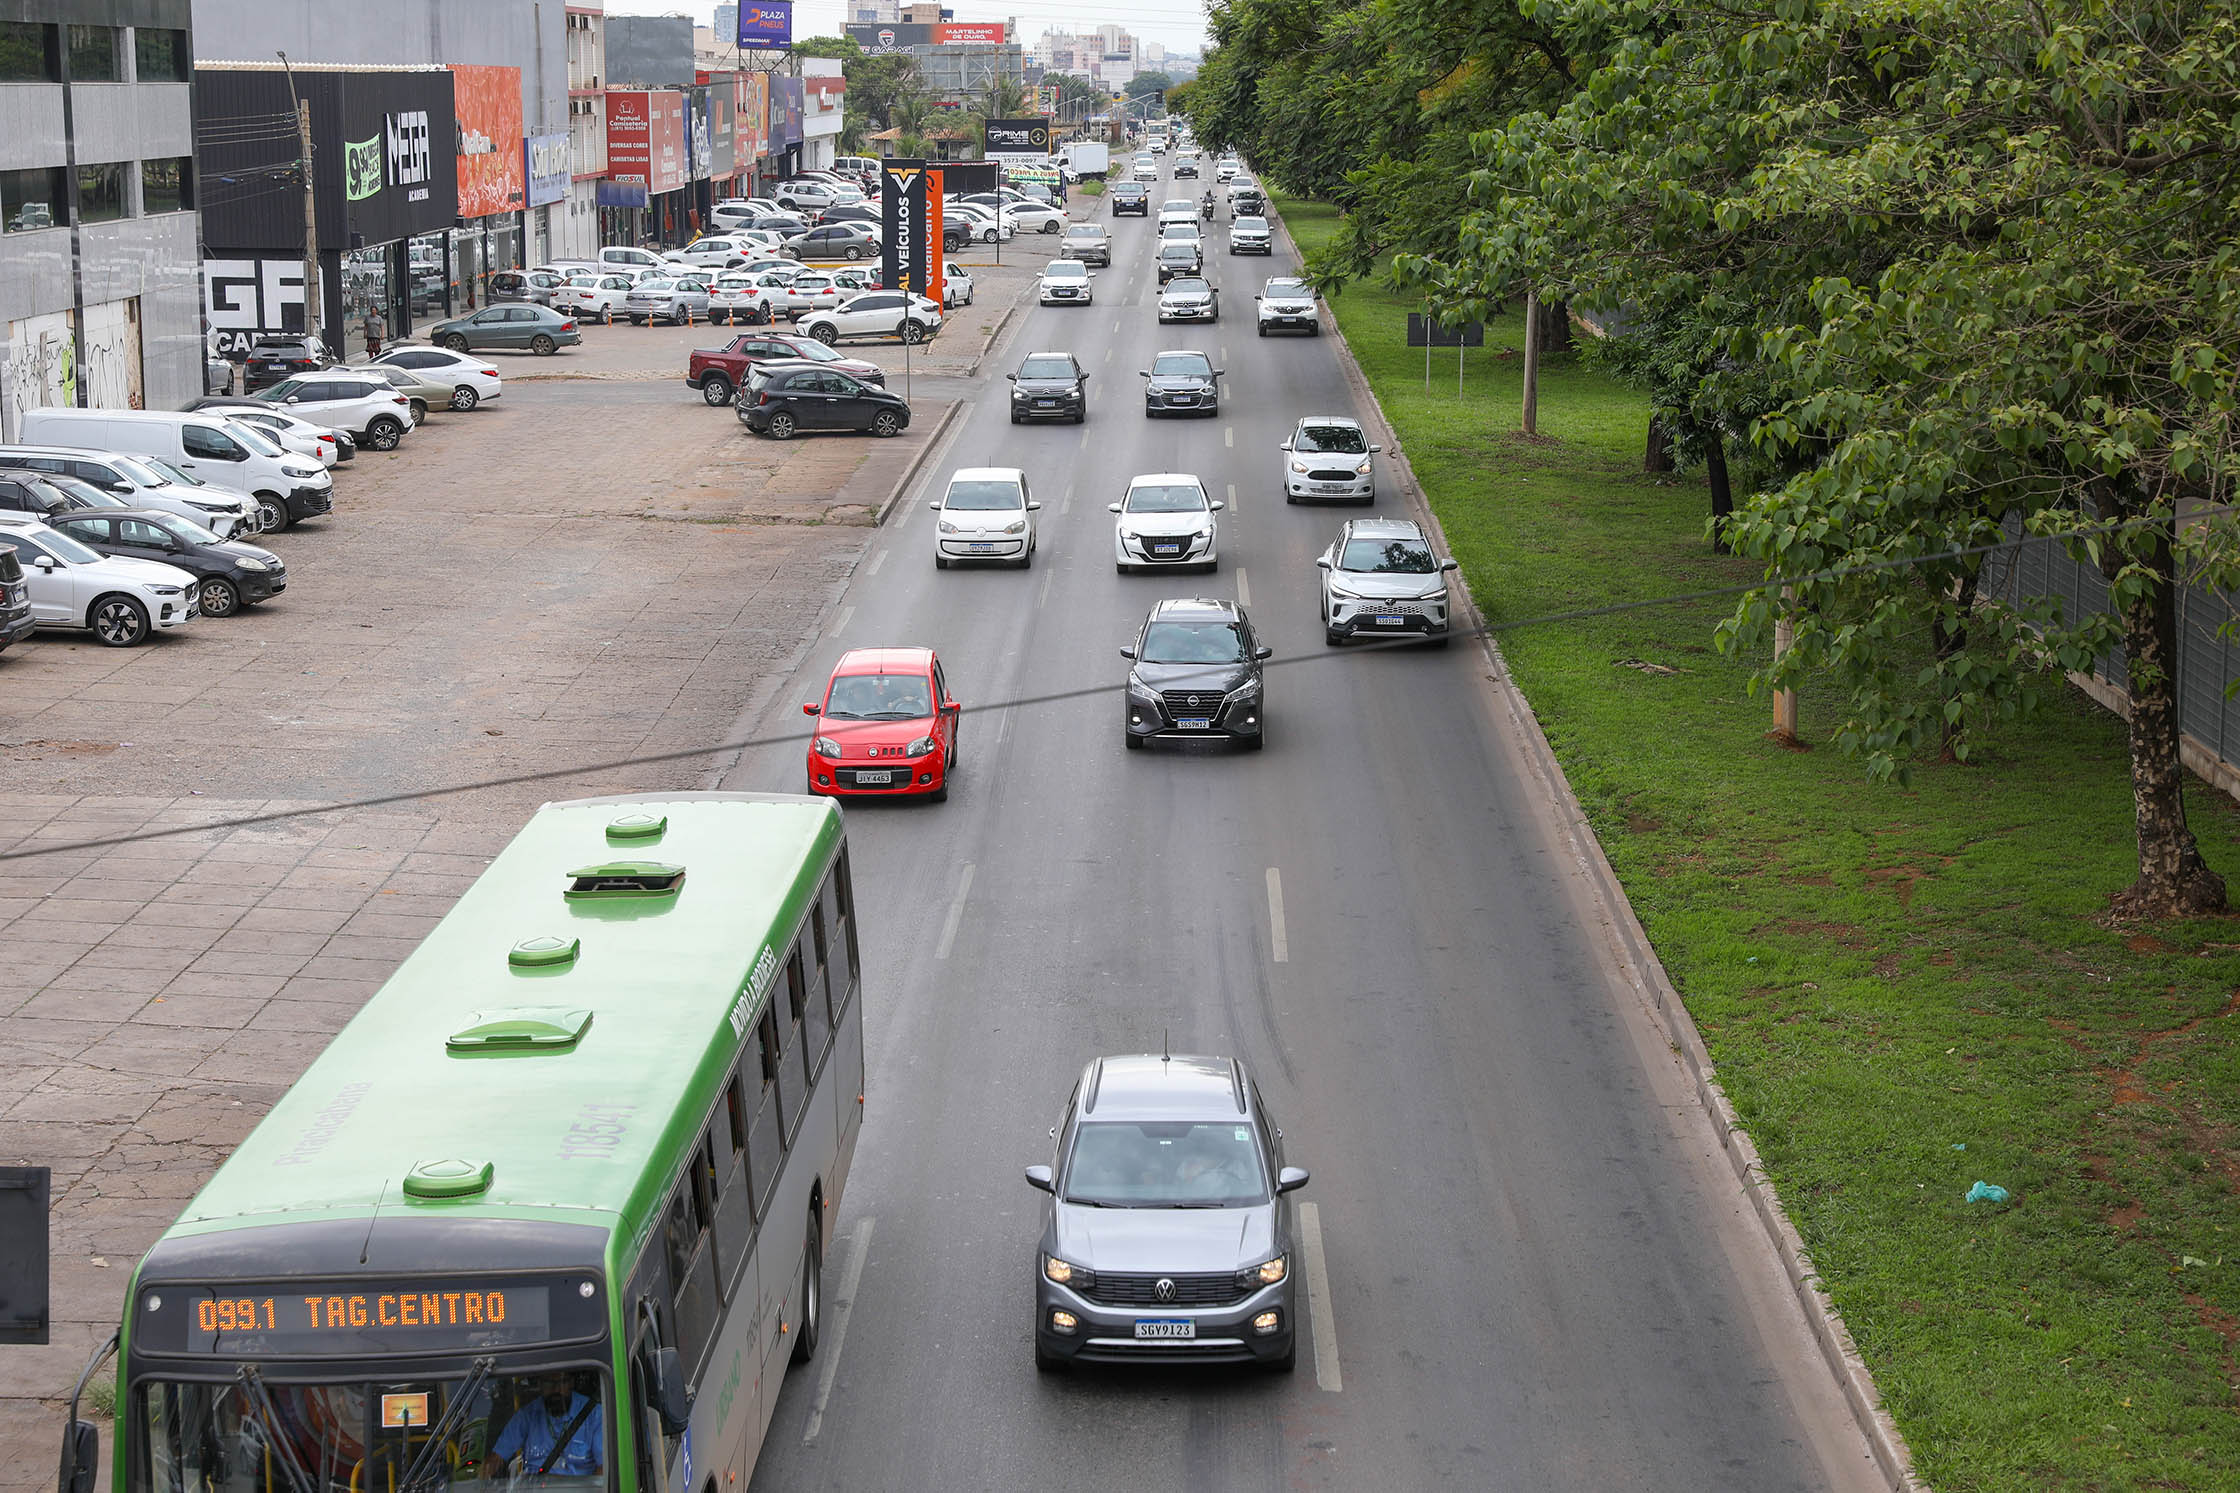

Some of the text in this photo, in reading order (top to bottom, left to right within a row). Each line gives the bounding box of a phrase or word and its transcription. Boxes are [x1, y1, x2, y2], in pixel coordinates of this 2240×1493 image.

[760, 11, 785, 19] PLAZA
[760, 20, 785, 28] PNEUS
[385, 110, 431, 186] MEGA
[896, 196, 910, 270] VEÍCULOS
[729, 989, 754, 1040] MOVIDO
[750, 943, 776, 1000] BIODIESEL
[554, 1103, 638, 1161] 118541
